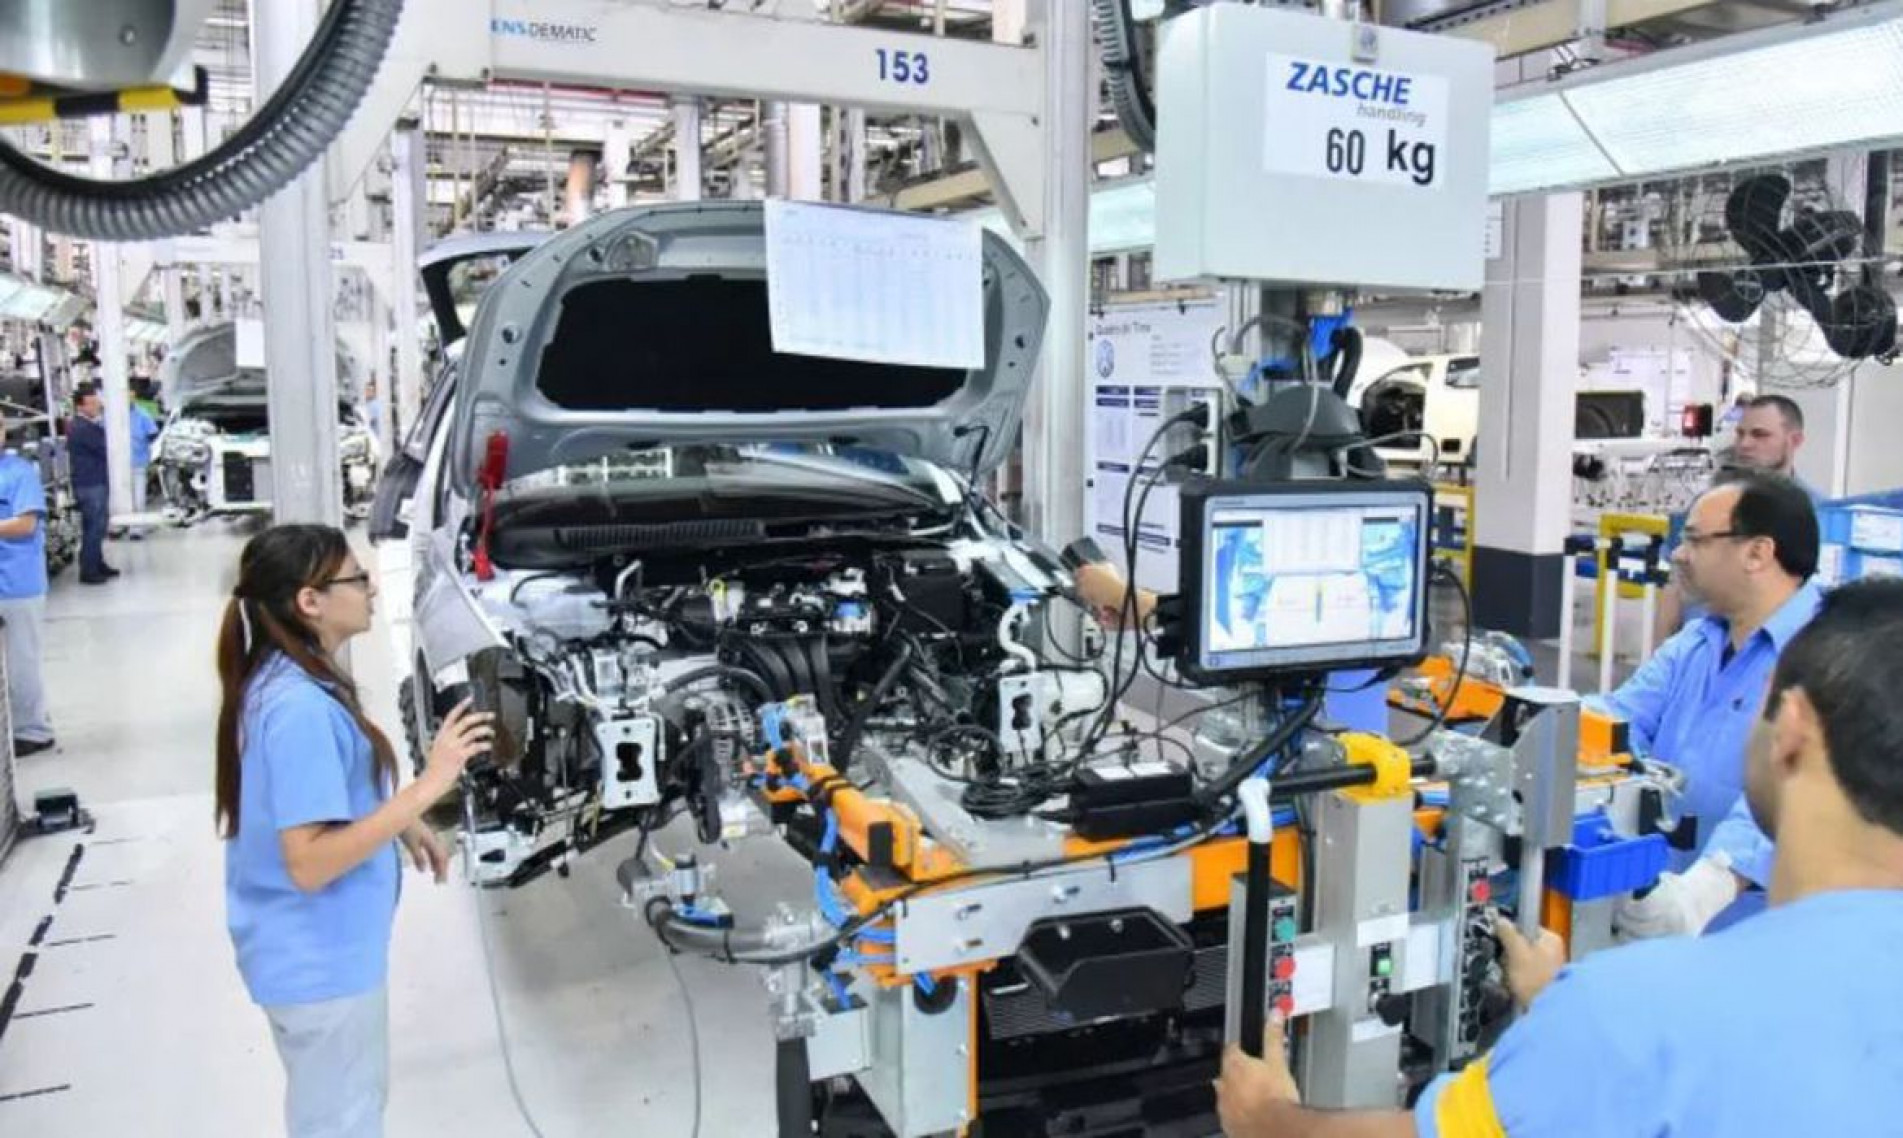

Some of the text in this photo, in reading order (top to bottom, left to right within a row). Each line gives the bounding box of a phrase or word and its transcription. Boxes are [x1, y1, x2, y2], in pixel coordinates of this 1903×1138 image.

[875, 48, 929, 84] 153
[1286, 61, 1412, 105] ZASCHE
[1356, 104, 1427, 128] handling
[1326, 127, 1436, 186] 60 kg
